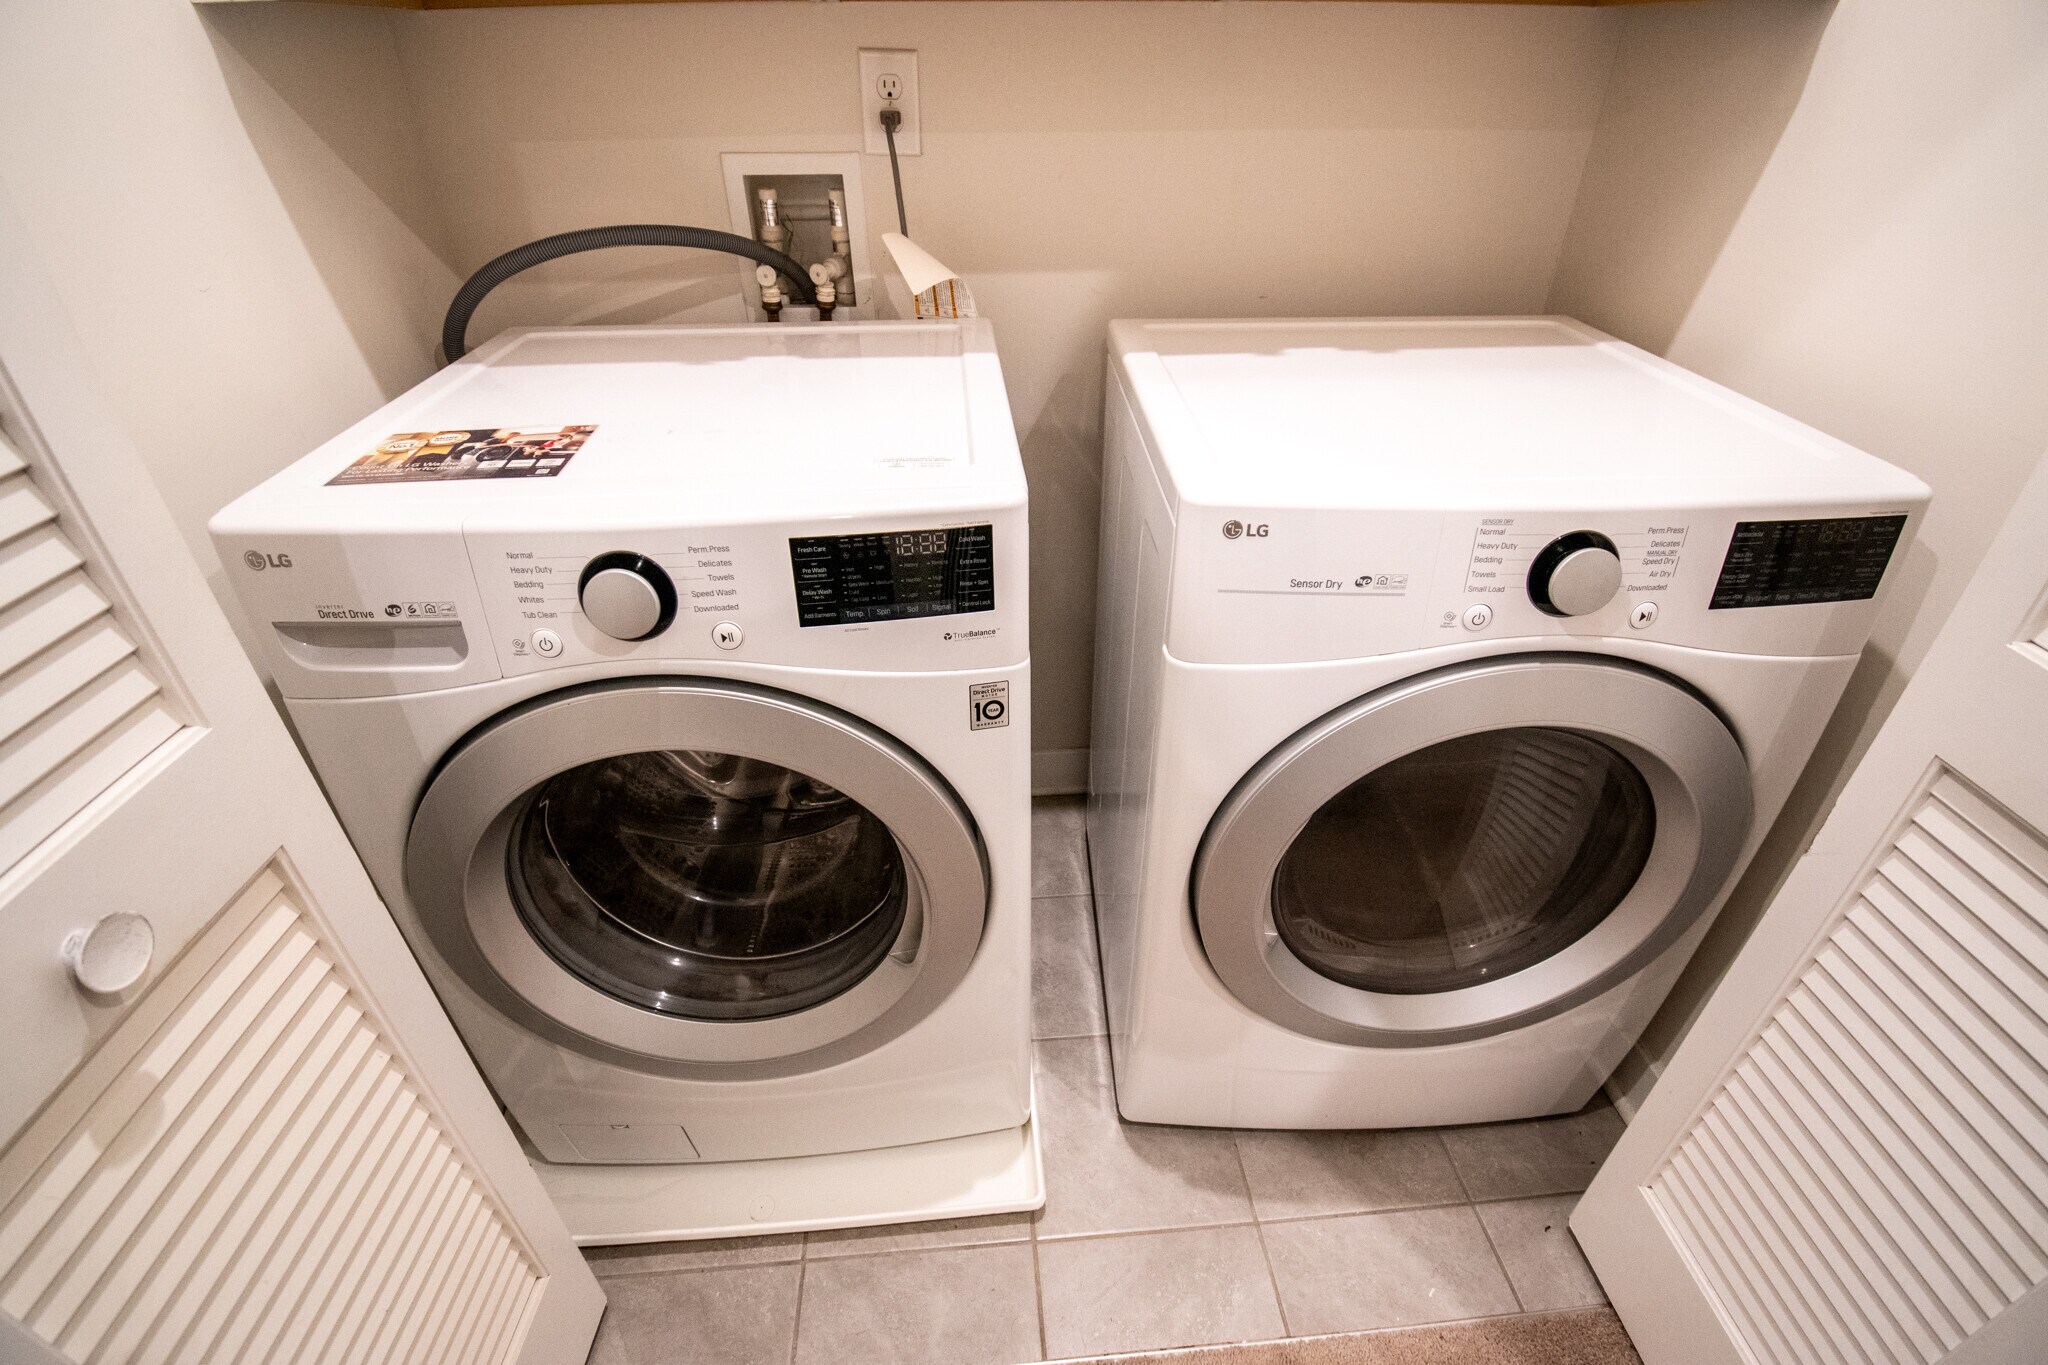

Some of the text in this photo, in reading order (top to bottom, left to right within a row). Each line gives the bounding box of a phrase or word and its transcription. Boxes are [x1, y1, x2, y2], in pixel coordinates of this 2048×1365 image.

[1246, 524, 1270, 538] LG
[1480, 528, 1506, 536] Normal
[1477, 542, 1518, 550] Heavy Duty
[1650, 540, 1681, 548] Delicates
[506, 552, 534, 560] Normal
[1474, 556, 1503, 564] Bedding
[266, 553, 292, 568] LG
[698, 560, 732, 568] Delicates
[1642, 558, 1676, 566] Speed Dry
[510, 566, 552, 574] Heavy Duty
[1472, 570, 1496, 578] Towels
[1649, 570, 1672, 578] Air Dry
[708, 574, 734, 582] Towels
[514, 580, 544, 590] Bedding
[1290, 578, 1343, 590] Sensor Dry
[1627, 584, 1668, 592] Downloaded
[692, 588, 737, 598] Speed Wash
[518, 596, 544, 604] Whites
[694, 604, 740, 612] Downloaded
[876, 608, 891, 616] Spin
[932, 604, 952, 612] Signal
[318, 610, 374, 620] Direct Drive
[522, 610, 558, 619] Tub Clean
[953, 630, 996, 638] TrueBalance
[973, 688, 990, 696] Direct
[974, 700, 1005, 722] 10
